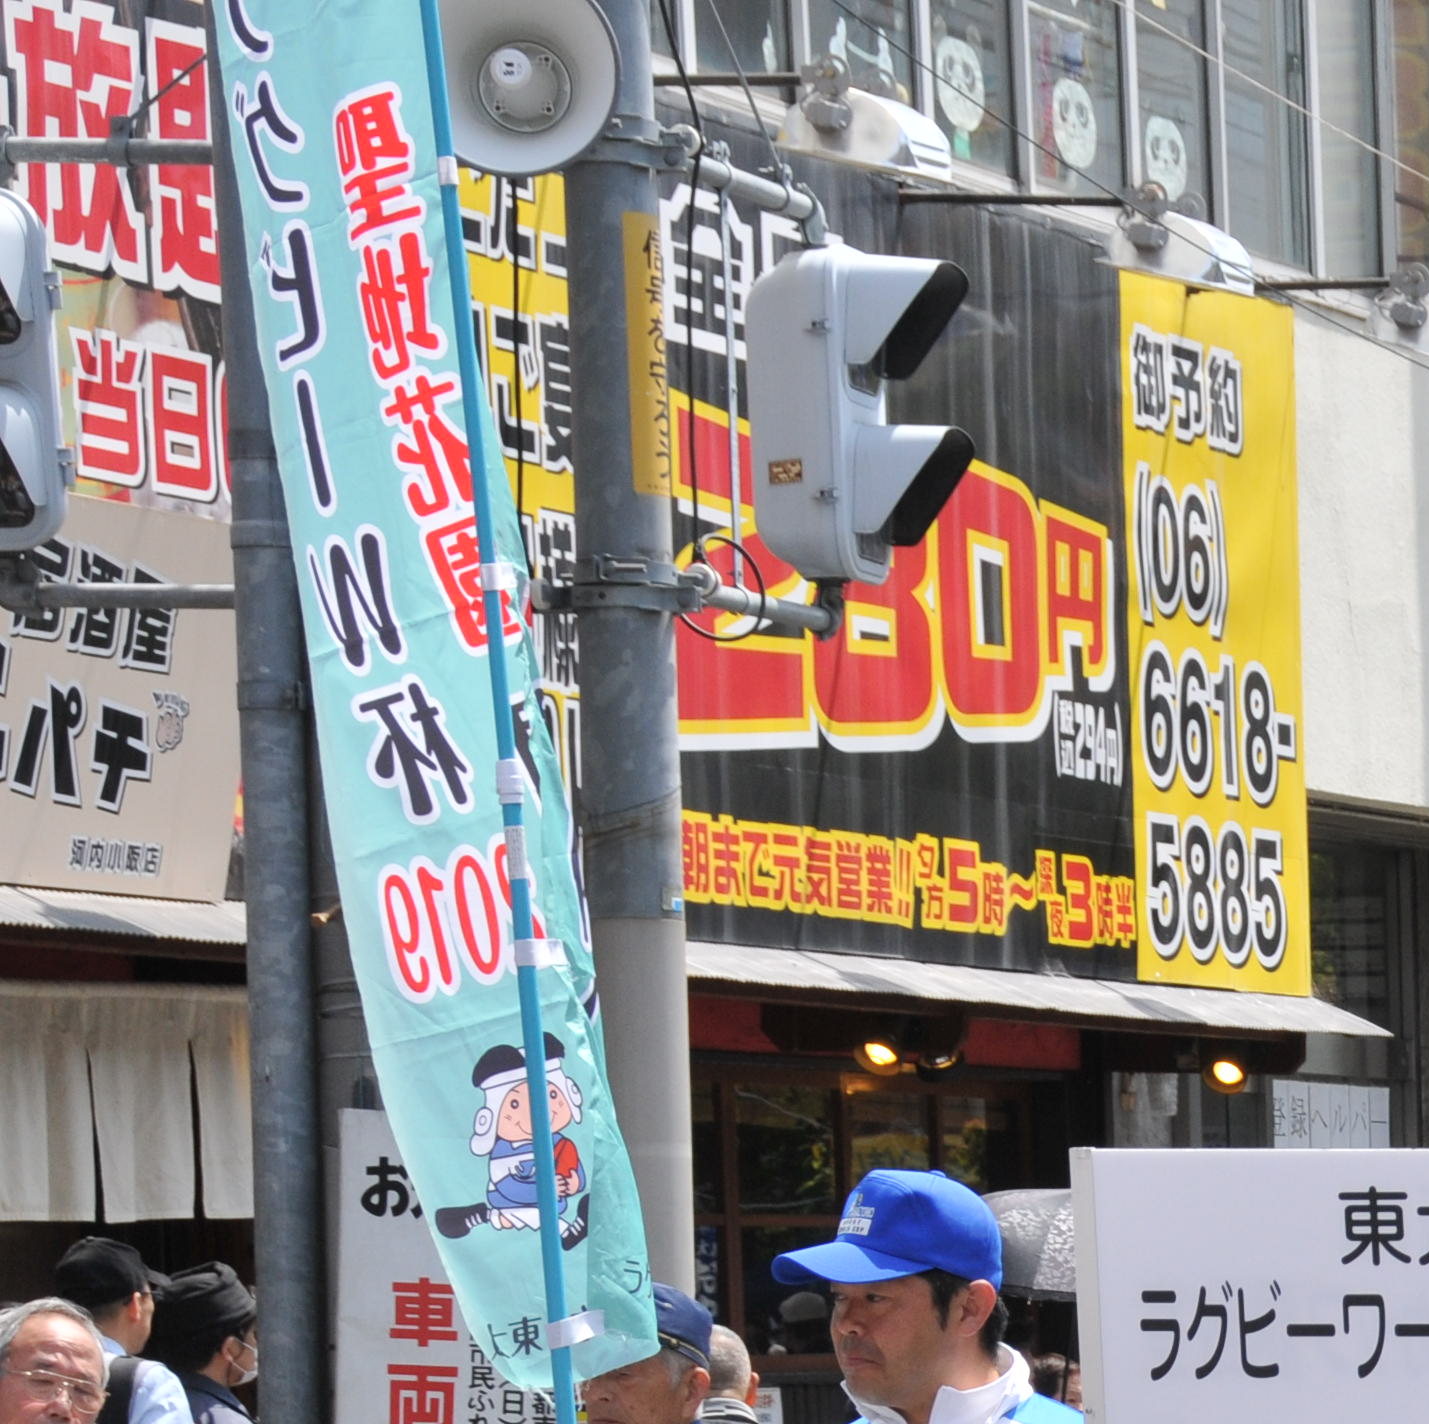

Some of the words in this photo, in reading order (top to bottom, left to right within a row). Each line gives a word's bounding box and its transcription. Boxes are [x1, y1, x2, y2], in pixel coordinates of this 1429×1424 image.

[75, 335, 233, 498] 当日
[1131, 323, 1242, 455] 御予約
[1134, 463, 1229, 640] (06)
[1146, 813, 1285, 969] 5885
